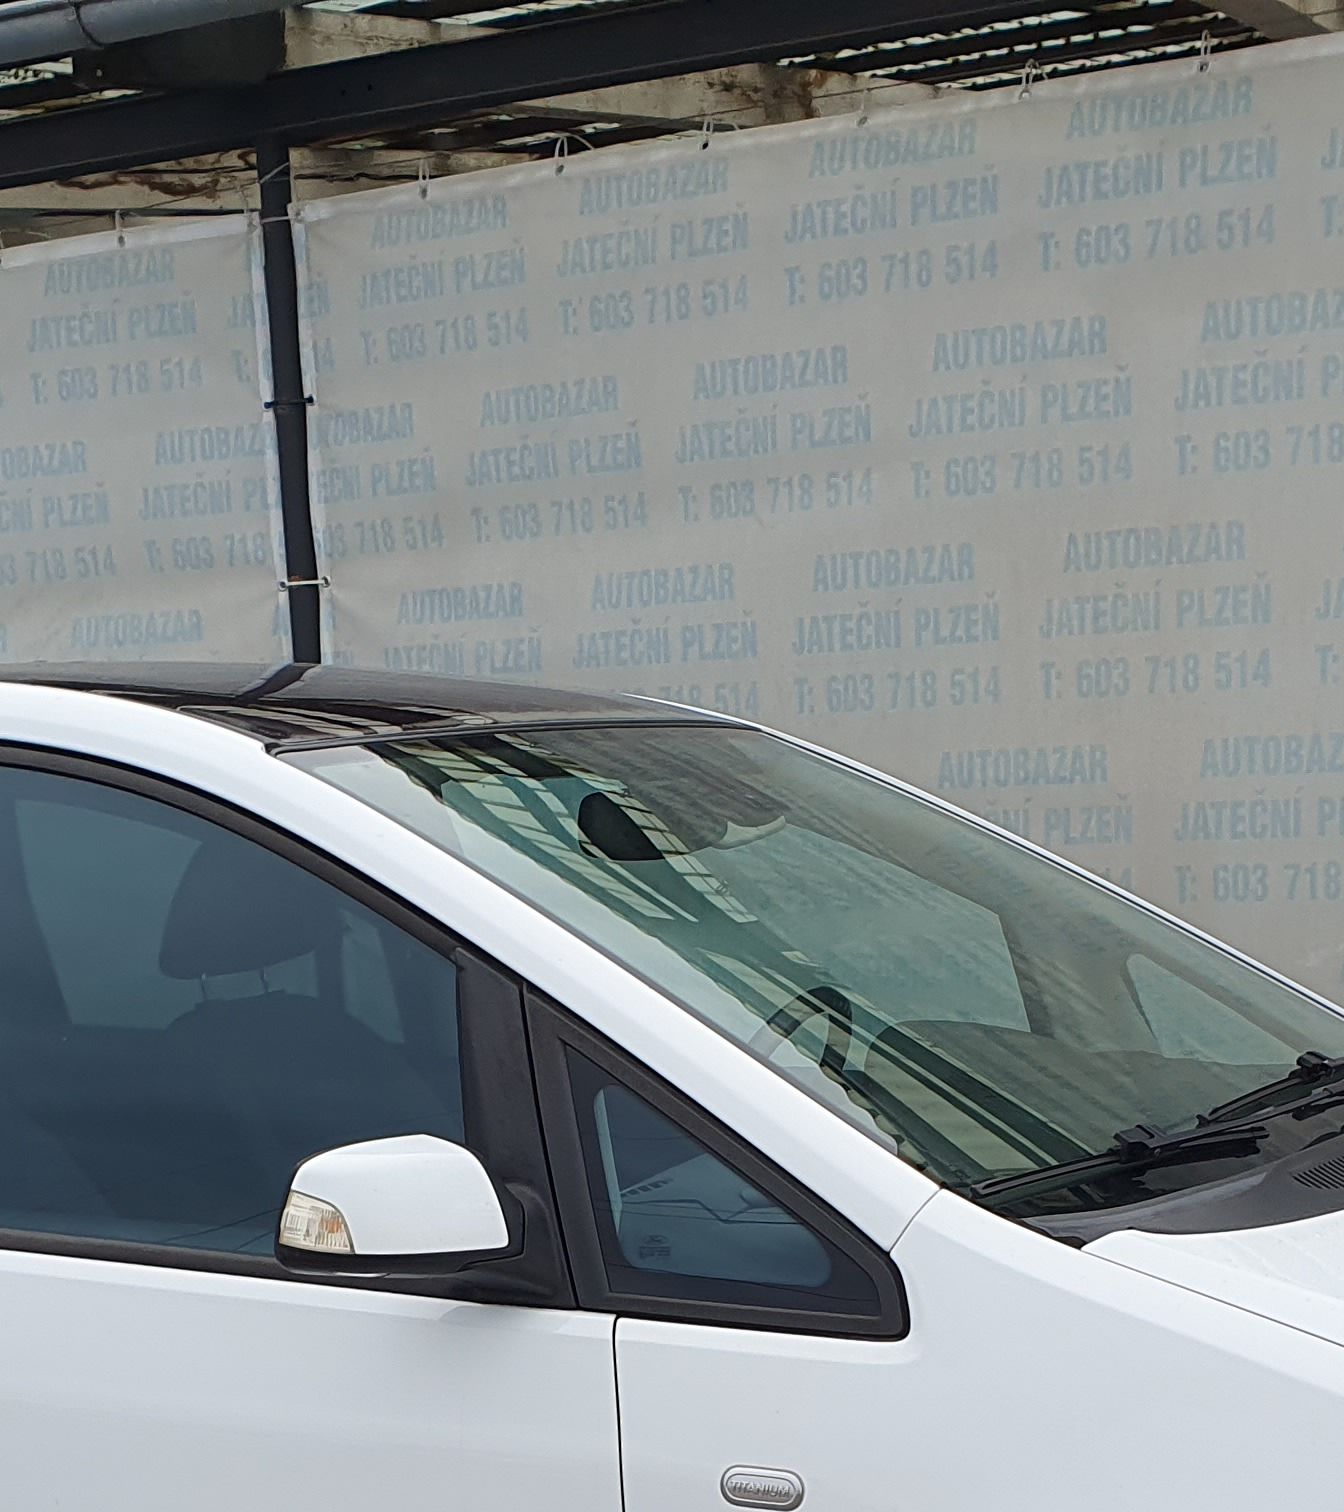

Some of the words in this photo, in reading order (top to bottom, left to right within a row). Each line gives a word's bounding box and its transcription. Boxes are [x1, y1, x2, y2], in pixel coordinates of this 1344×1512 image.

[1067, 76, 1256, 139] AUTOBAZAR
[809, 119, 976, 178] AUTOBAZAR
[1038, 145, 1164, 209] JATEČNÍ
[1179, 124, 1277, 189] PLZEŇ
[577, 157, 728, 218] AUTOBAZAR
[784, 176, 899, 245] JATEČNÍ
[910, 165, 999, 226] PLZEŇ
[371, 196, 508, 249] AUTOBAZAR
[556, 215, 659, 281] JATEČNÍ
[670, 204, 749, 262] PLZEŇ
[1075, 223, 1131, 267] 603
[1146, 214, 1207, 259] 718
[1216, 205, 1274, 250] 514
[44, 252, 174, 296] AUTOBAZAR
[819, 256, 868, 302] 603
[881, 248, 932, 292] 718
[945, 241, 998, 284] 514
[589, 291, 634, 332] 603
[644, 282, 690, 324] 718
[701, 274, 747, 318] 514
[387, 323, 426, 361] 603
[435, 314, 478, 355] 718
[487, 307, 529, 347] 514
[933, 316, 1107, 372] AUTOBAZAR
[694, 345, 848, 400] AUTOBAZAR
[1174, 344, 1306, 413] JATEČNÍ
[481, 375, 618, 428] AUTOBAZAR
[675, 408, 778, 464] JATEČNÍ
[790, 393, 871, 452] PLZEŇ
[908, 373, 1028, 444] JATEČNÍ
[1040, 362, 1132, 426] PLZEŇ
[465, 431, 559, 489] JATEČNÍ
[569, 420, 643, 476] PLZEŇ
[945, 454, 997, 497] 603
[1011, 449, 1063, 488] 718
[1078, 445, 1132, 486] 514
[1213, 430, 1270, 473] 603
[498, 502, 542, 540] 603
[550, 497, 593, 534] 718
[604, 492, 647, 529] 514
[710, 479, 755, 518] 603
[765, 472, 814, 512] 718
[824, 469, 873, 509] 514
[813, 543, 974, 592] AUTOBAZAR
[1063, 521, 1245, 573] AUTOBAZAR
[592, 563, 734, 611] AUTOBAZAR
[1039, 579, 1162, 640] JATEČNÍ
[1177, 570, 1272, 629] PLZEŇ
[72, 609, 204, 650] AUTOBAZAR
[572, 617, 671, 670] JATEČNÍ
[681, 610, 758, 664] PLZEŇ
[792, 598, 902, 656] JATEČNÍ
[914, 591, 1000, 646] PLZEŇ
[826, 675, 874, 712] 603
[887, 671, 936, 709] 718
[949, 666, 1001, 706] 514
[1076, 658, 1129, 699] 603
[1145, 654, 1200, 694] 718
[1216, 648, 1271, 689] 514
[936, 746, 1107, 790] AUTOBAZAR
[1173, 786, 1303, 844] JATEČNÍ
[1212, 864, 1268, 903] 603
[1284, 861, 1341, 903] 718
[729, 1480, 792, 1499] TITANIUM
